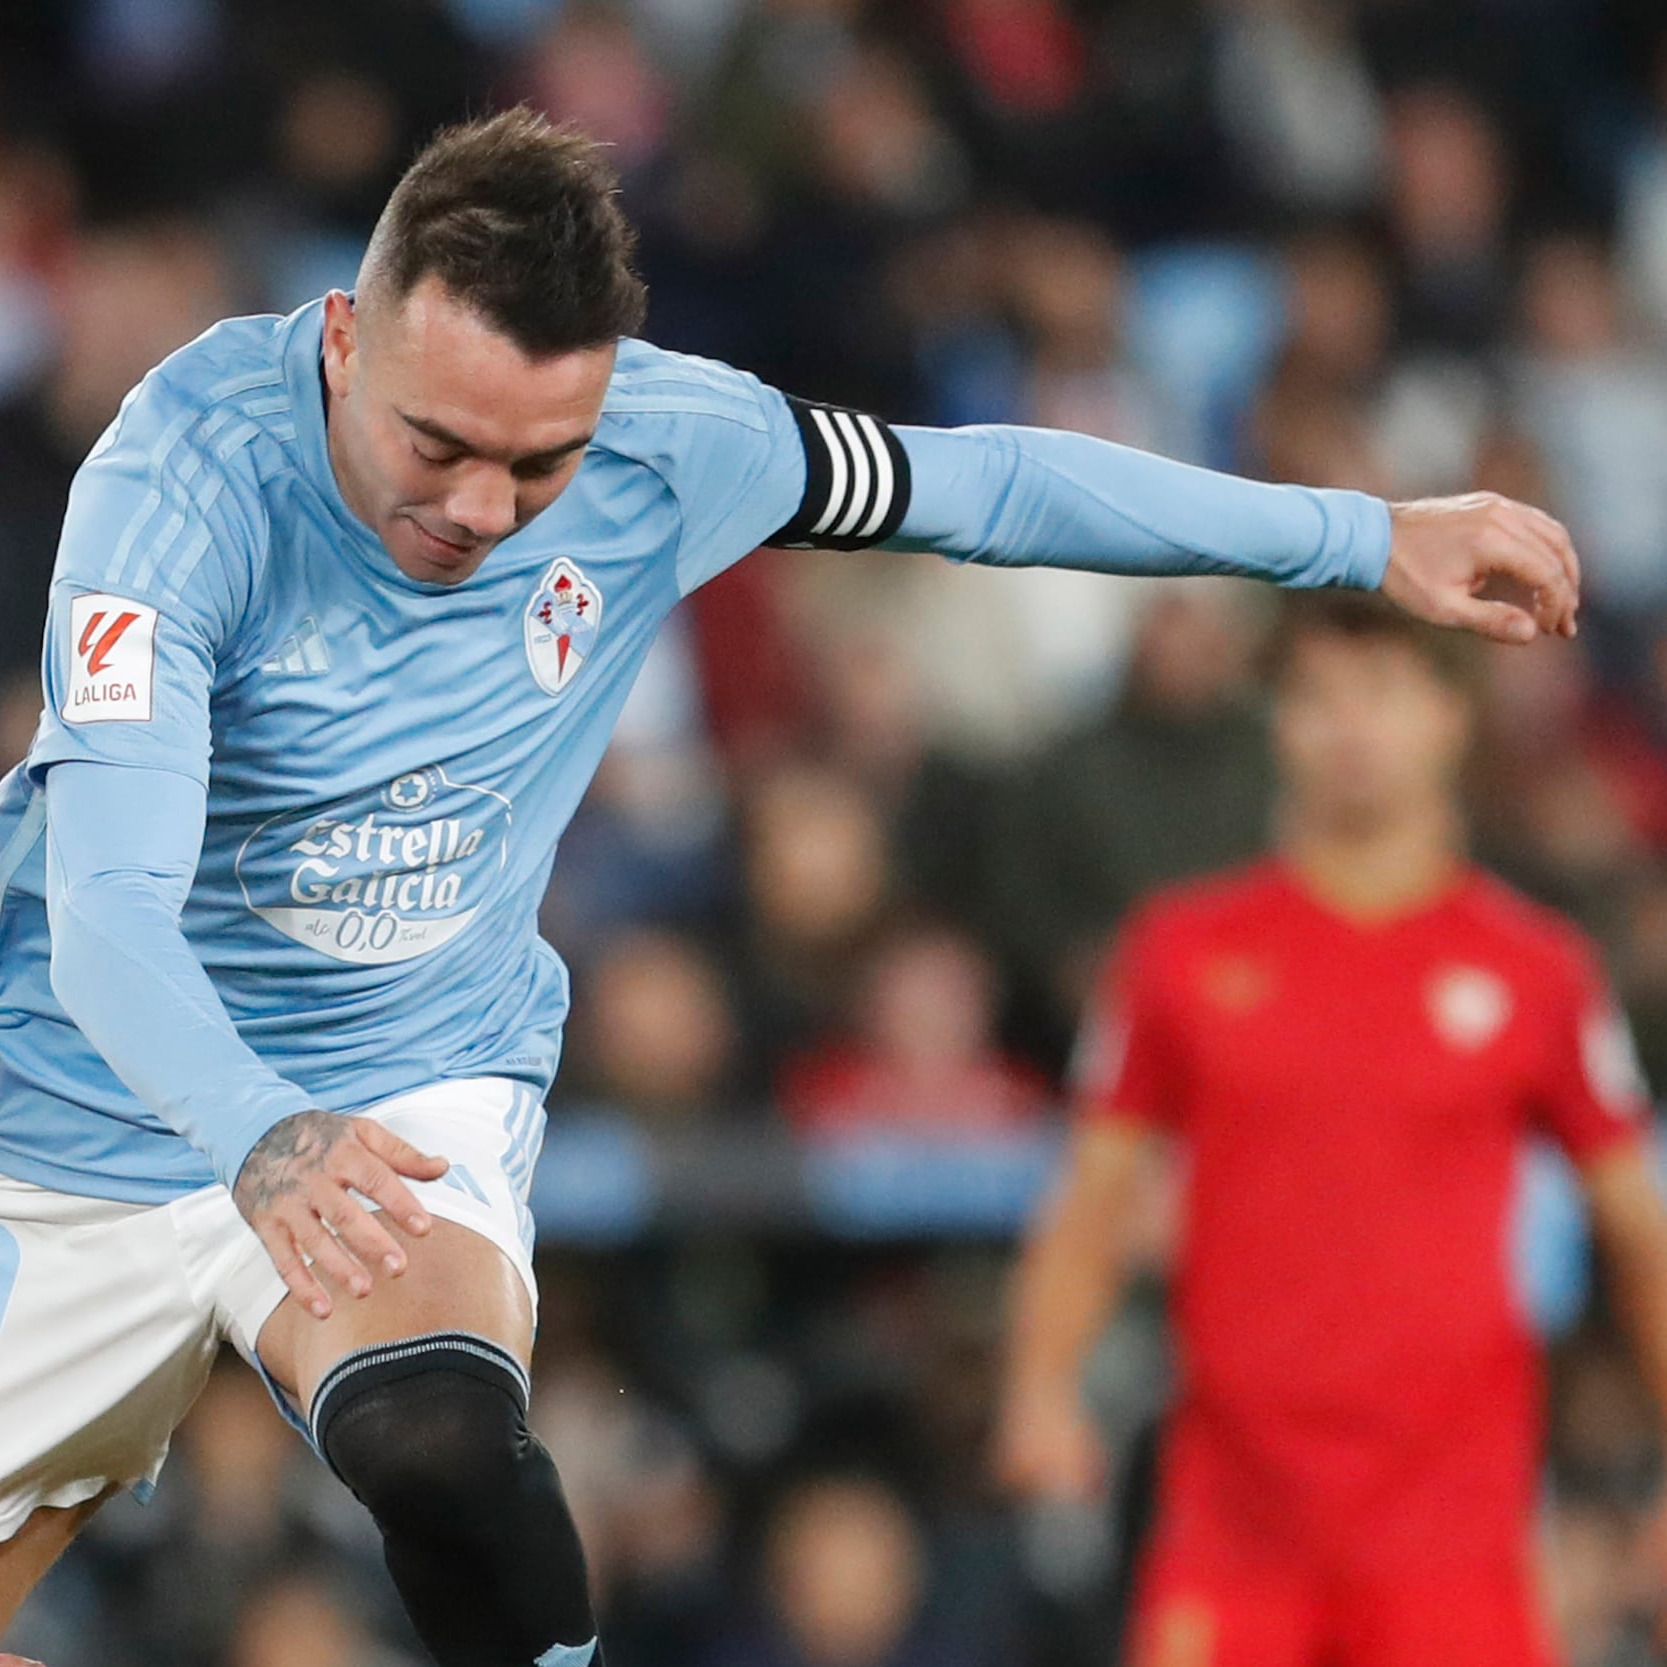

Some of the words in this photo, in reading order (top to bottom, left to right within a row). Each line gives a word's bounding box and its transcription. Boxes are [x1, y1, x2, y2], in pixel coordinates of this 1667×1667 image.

[75, 683, 137, 706] LALIGA
[290, 814, 485, 867] Estrella
[290, 857, 463, 911] Galicia
[336, 911, 398, 951] 0,0
